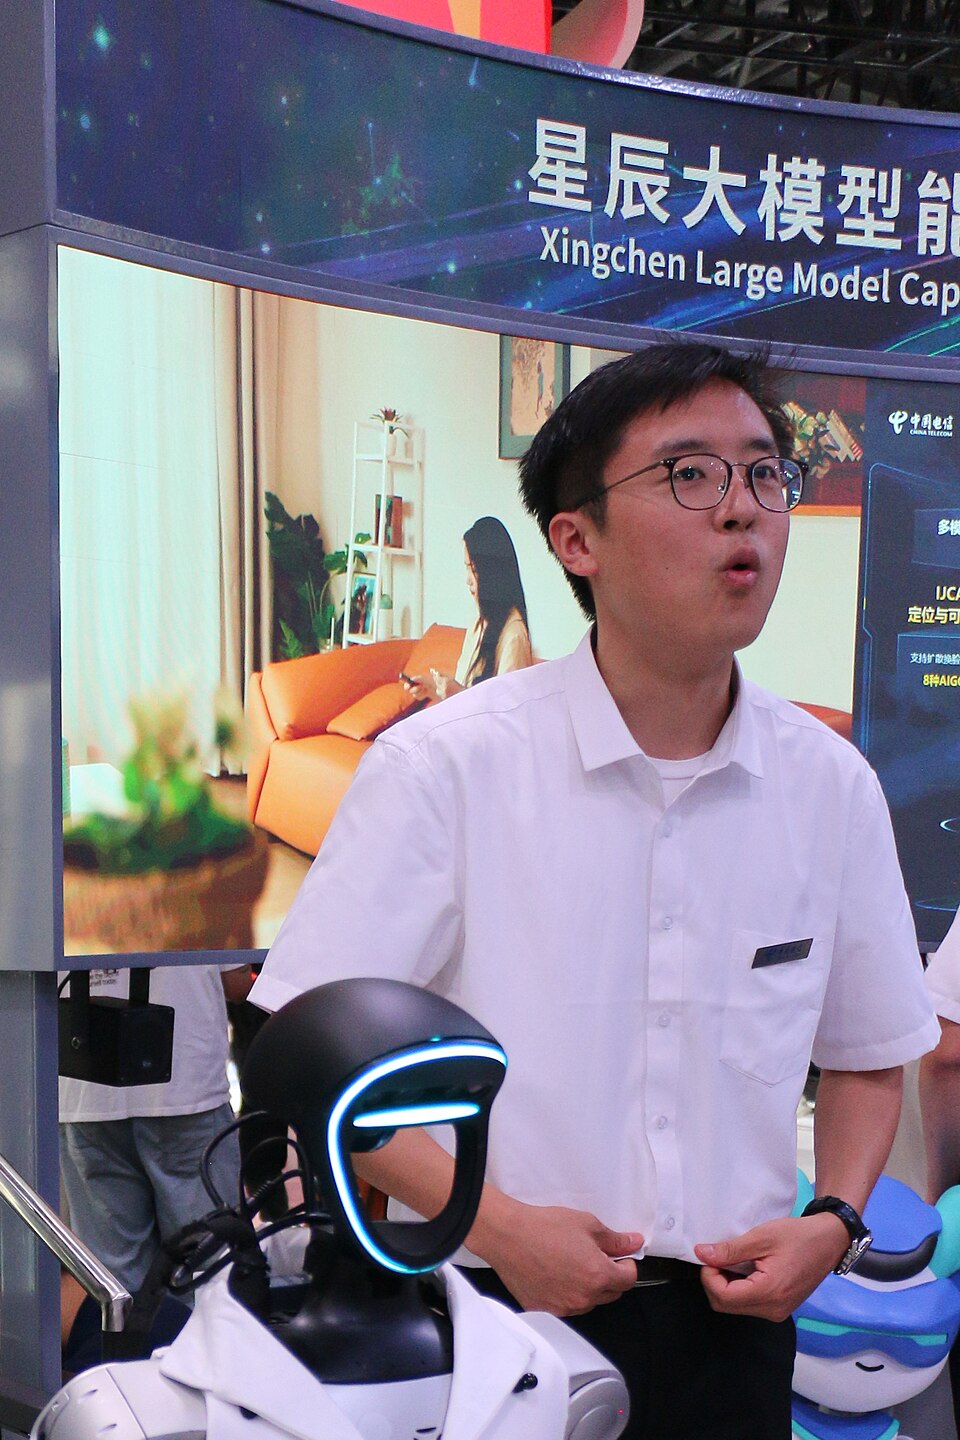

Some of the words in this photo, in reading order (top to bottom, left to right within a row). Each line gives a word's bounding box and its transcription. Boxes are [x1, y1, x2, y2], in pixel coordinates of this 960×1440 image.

[528, 117, 960, 257] 星辰大模型能
[540, 226, 685, 281] Xingchen
[696, 250, 783, 300] Large
[793, 261, 890, 304] Model
[899, 271, 960, 316] Cap
[910, 412, 954, 431] 中国电信
[908, 605, 960, 625] 定位与可
